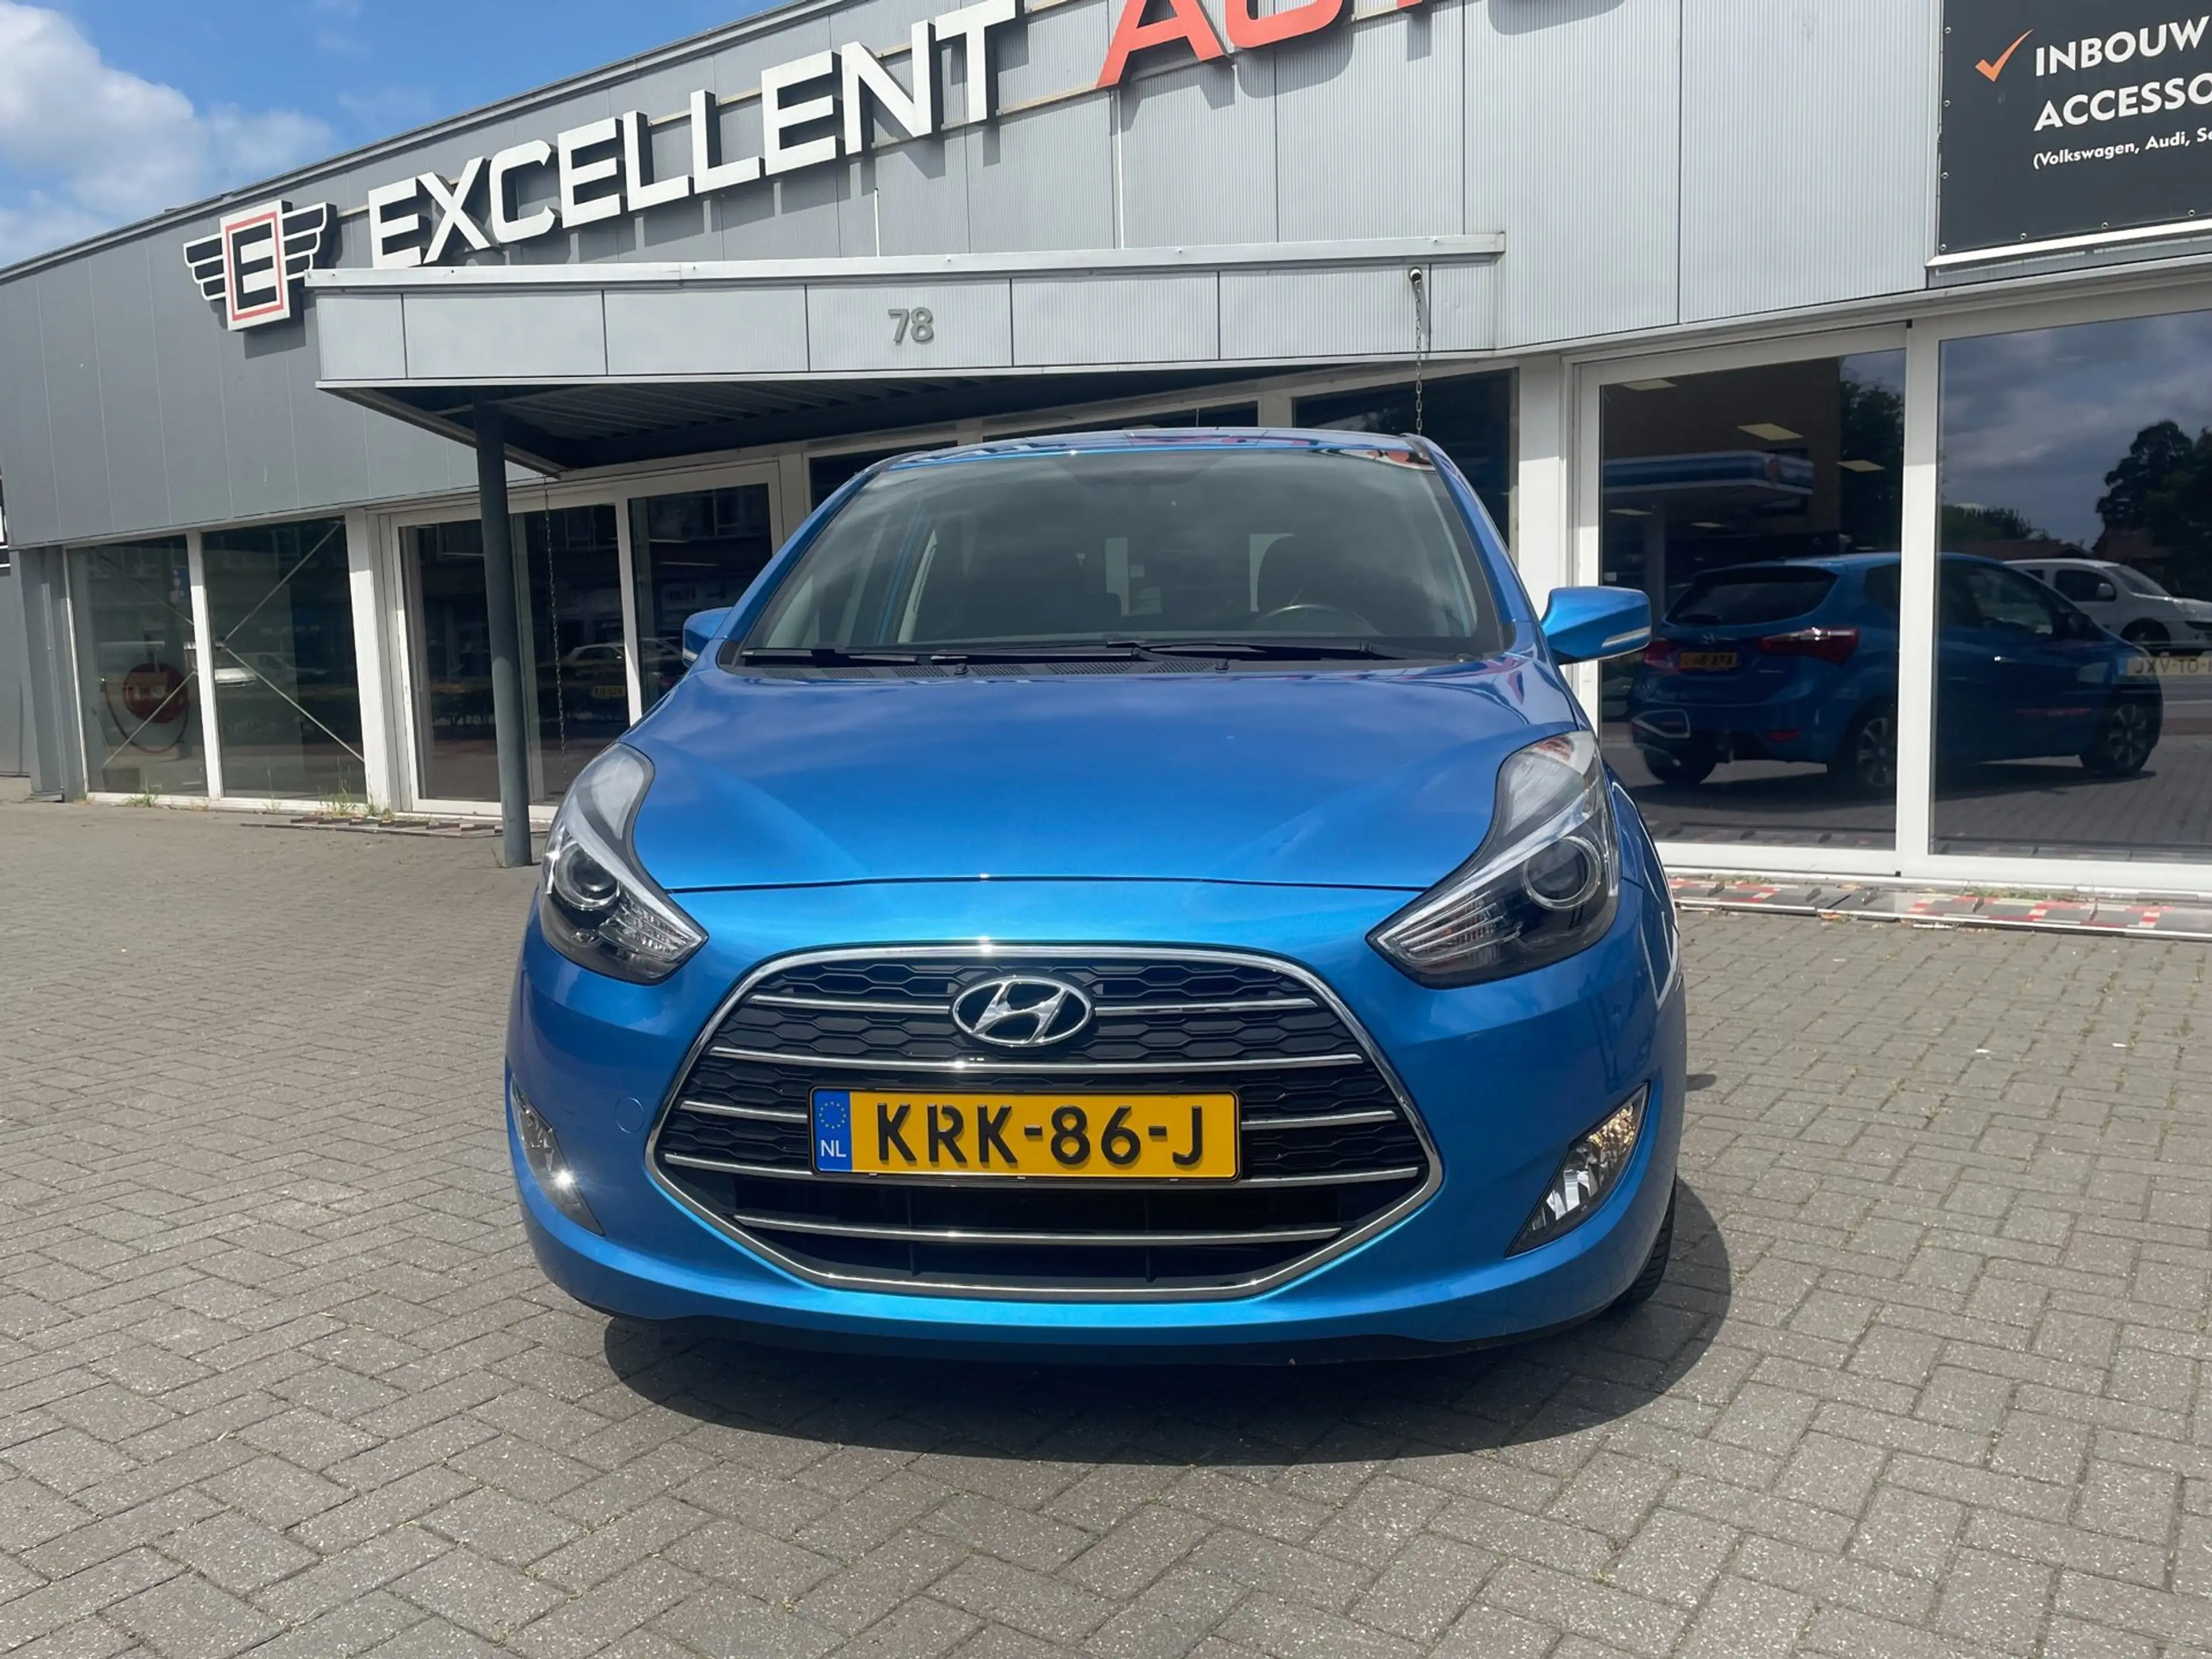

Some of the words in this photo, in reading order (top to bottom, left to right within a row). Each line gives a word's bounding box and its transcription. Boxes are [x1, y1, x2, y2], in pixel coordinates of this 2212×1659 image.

[2035, 16, 2210, 77] INBOUW
[2033, 73, 2212, 131] ACCESSO
[368, 0, 1016, 269] EXCELLENT
[2033, 143, 2140, 169] (Volkswagen,
[2145, 131, 2191, 150] Audi,
[888, 306, 934, 344] 78
[821, 1139, 847, 1158] NL
[877, 1102, 1203, 1166] KRK-86-J
